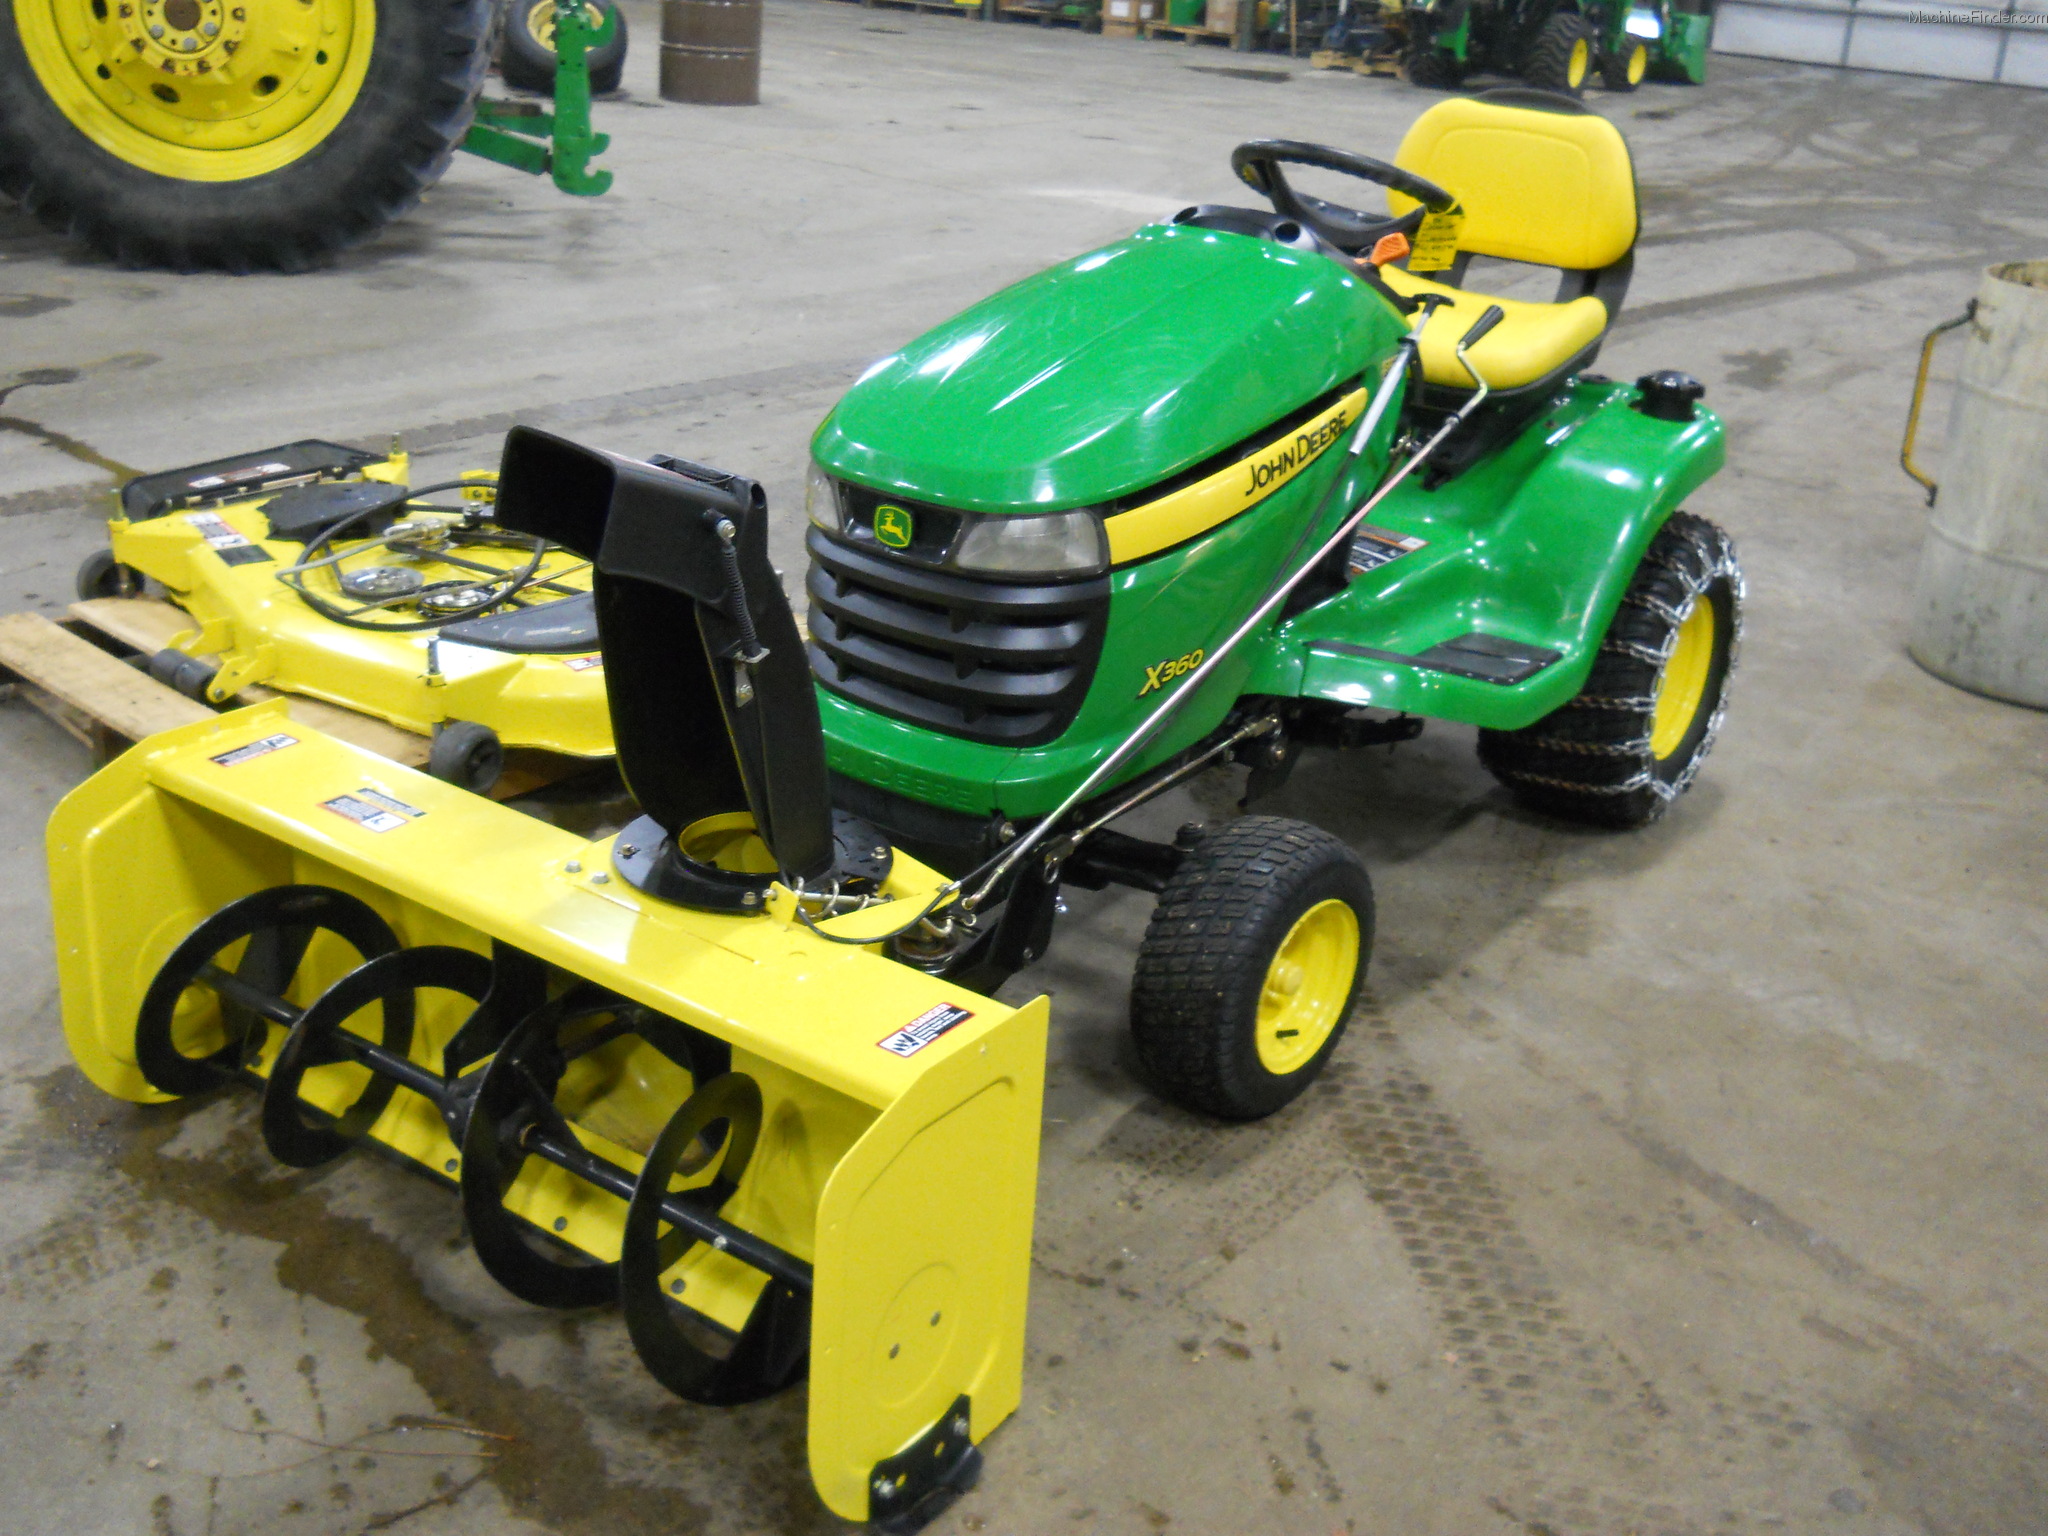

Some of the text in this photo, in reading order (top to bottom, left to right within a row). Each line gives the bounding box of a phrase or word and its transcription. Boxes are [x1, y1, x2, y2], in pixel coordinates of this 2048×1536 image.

[1245, 409, 1347, 496] JOHN DEERE
[1137, 648, 1204, 698] X360
[912, 1003, 951, 1028] DANGER
